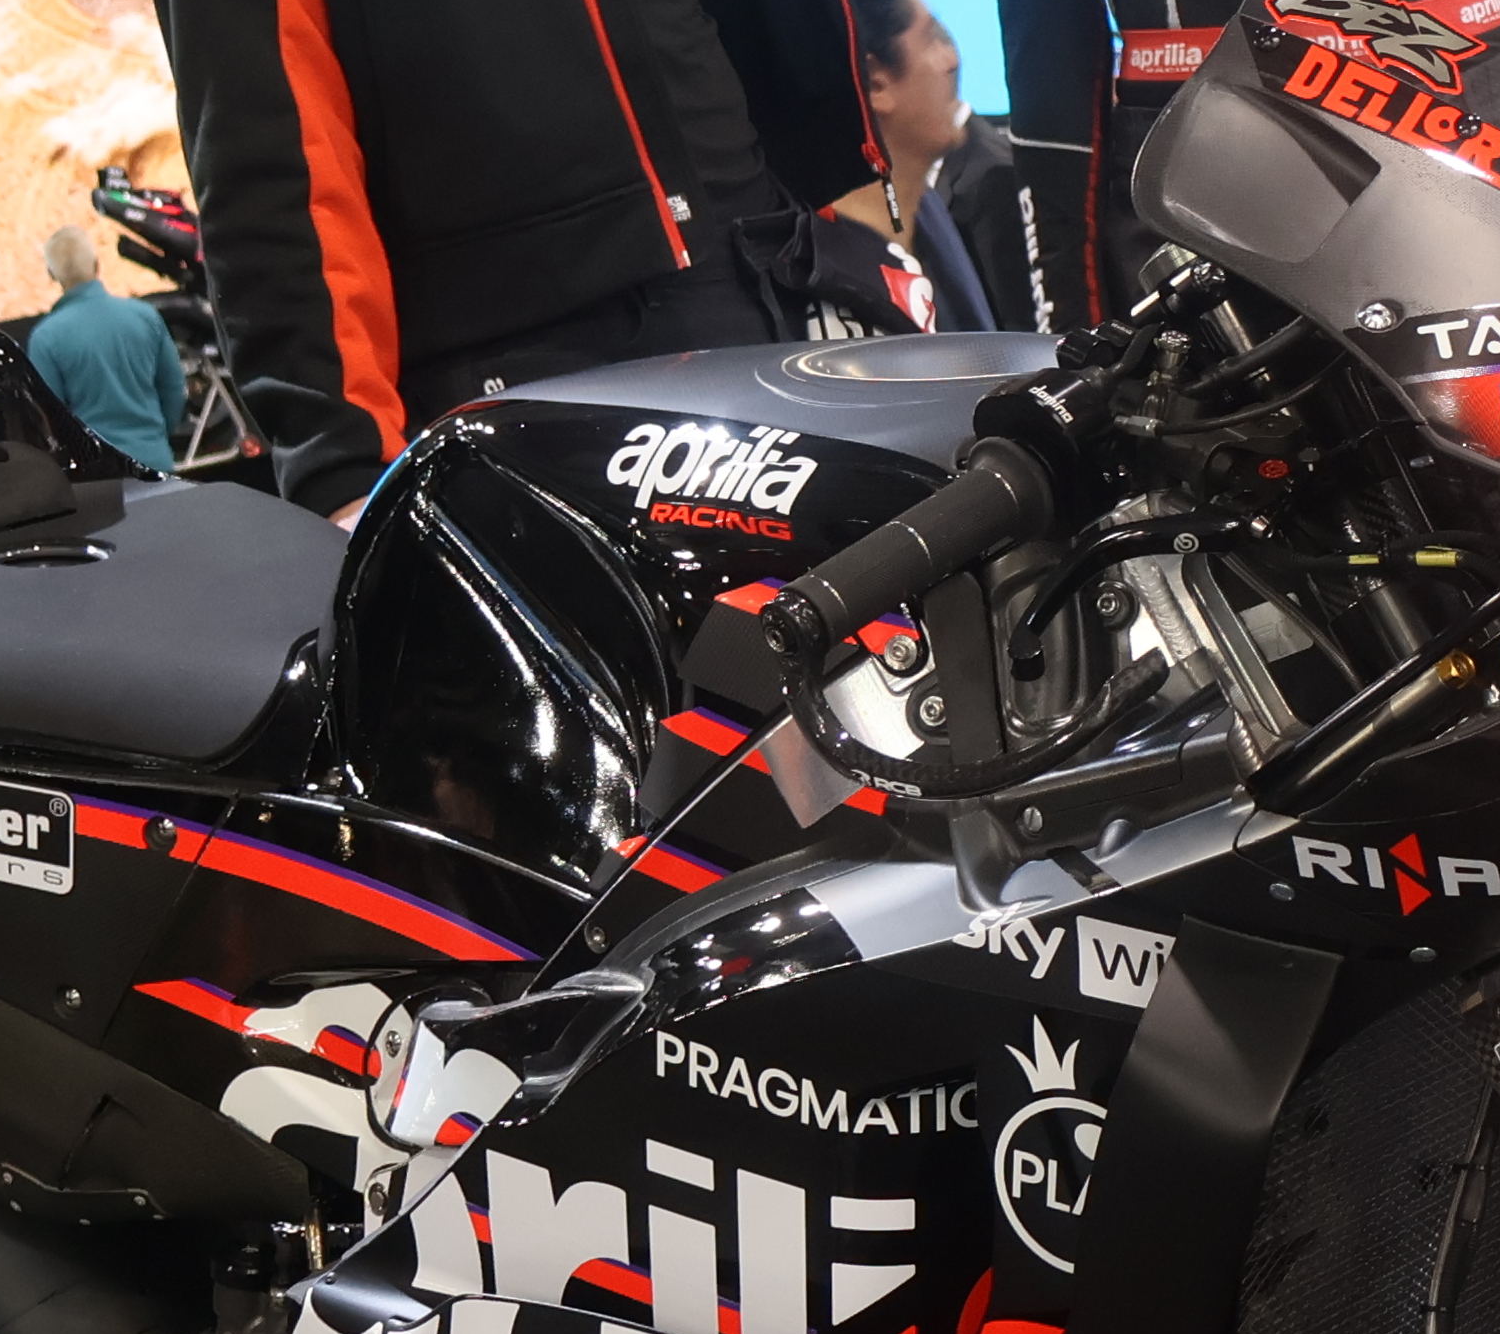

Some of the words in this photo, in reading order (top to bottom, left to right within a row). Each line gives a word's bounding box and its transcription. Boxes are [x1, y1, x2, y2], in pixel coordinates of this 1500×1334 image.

[1129, 41, 1203, 69] aprilia
[606, 423, 819, 516] aprilia
[648, 502, 795, 542] RACING
[873, 776, 923, 798] RCB
[951, 901, 1060, 981] sky
[656, 1030, 980, 1135] PRAGMATIC
